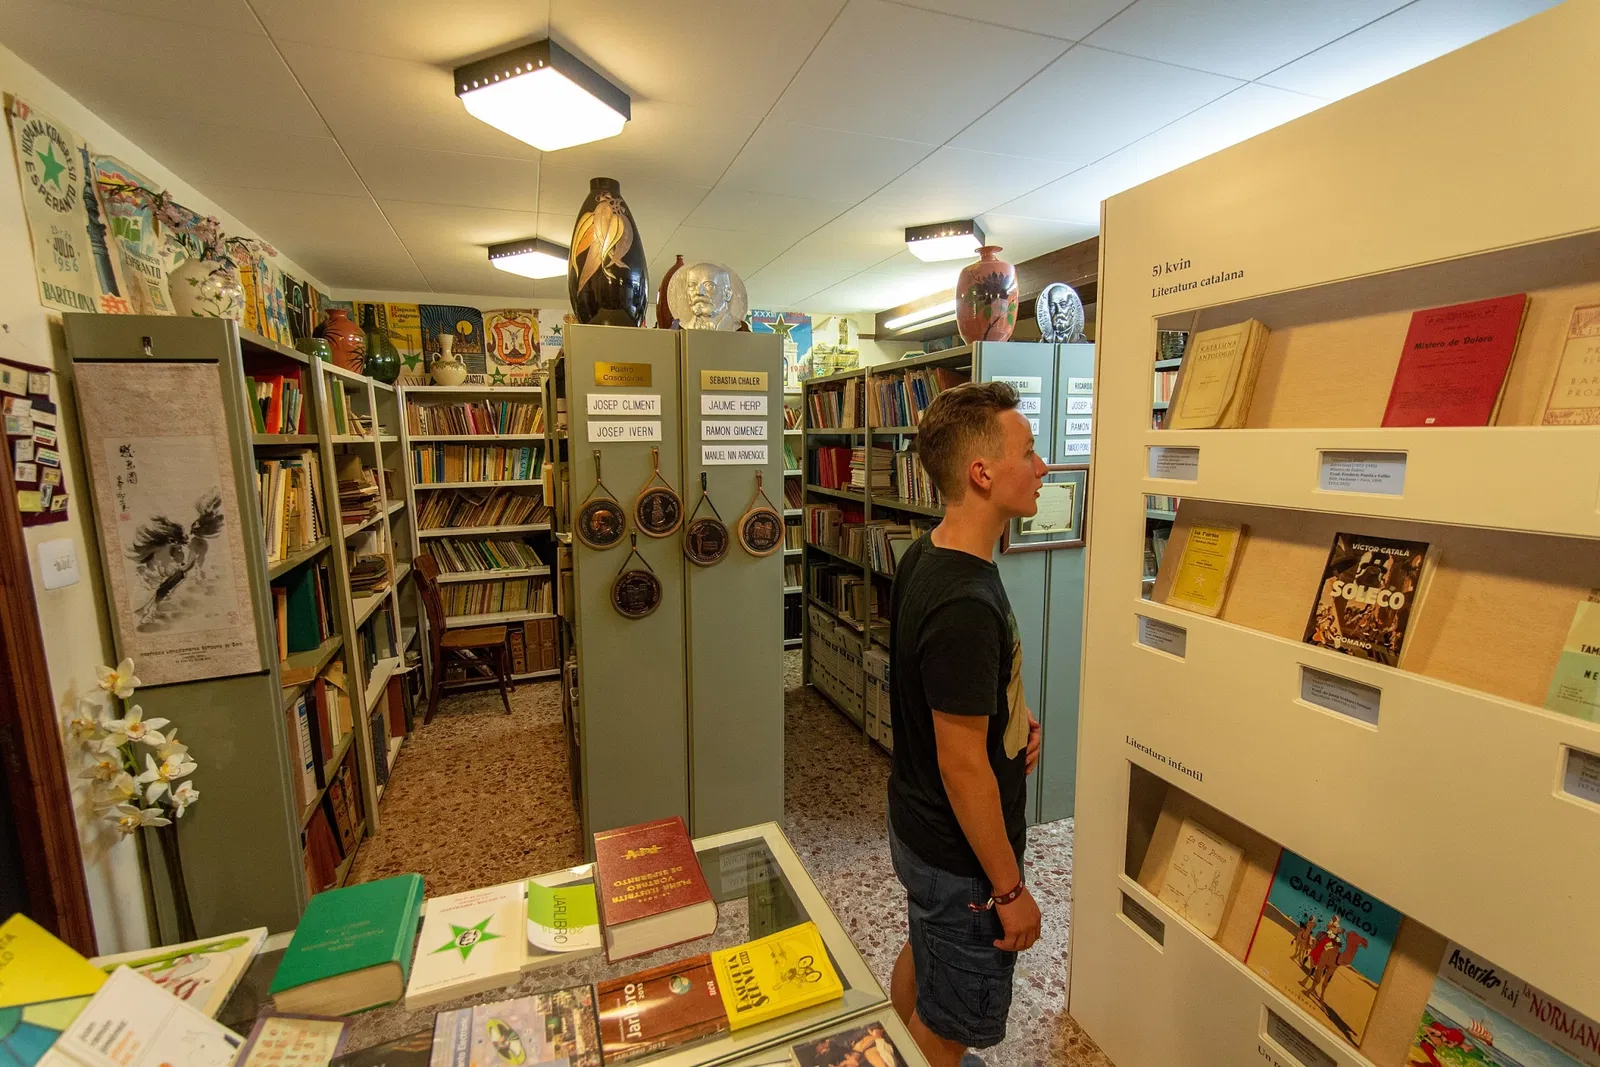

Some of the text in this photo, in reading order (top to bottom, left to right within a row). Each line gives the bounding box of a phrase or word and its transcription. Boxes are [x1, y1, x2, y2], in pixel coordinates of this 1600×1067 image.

[22, 119, 78, 182] HISPANA KONGRESO
[24, 160, 78, 214] ESPERANTO
[53, 253, 80, 272] 1956
[1152, 258, 1192, 278] 5) kvin
[1152, 268, 1245, 298] Literatura catalana
[42, 281, 97, 315] BARCELONA
[1413, 340, 1446, 350] Mistero
[1449, 339, 1459, 347] de
[738, 377, 760, 385] CHALER
[593, 399, 655, 411] JOSEP CLIMENT
[708, 400, 761, 411] JAUME HERP
[597, 426, 653, 438] JOSEP IVERN
[706, 426, 763, 436] RAMON GIMENEZ
[1070, 423, 1090, 431] RAMON
[704, 450, 765, 460] MANUEL NIN ARMENGOL
[1331, 580, 1404, 610] SOLECO
[1335, 634, 1372, 650] ROMANO
[1126, 735, 1204, 783] Literatura infantil
[613, 869, 668, 887] ESPERANTO
[627, 875, 674, 892] VORTARO
[611, 886, 662, 904] ILUSTRITA
[1306, 866, 1373, 914] LA KRABO
[1289, 876, 1378, 937] ORAJ PINĈILOJ
[552, 895, 568, 944] JARLIBRO
[636, 983, 645, 999] 2013
[741, 965, 770, 1009] SERVO
[1448, 949, 1501, 989] Asteriks
[1500, 980, 1519, 1008] kaj
[1522, 984, 1531, 999] la
[1529, 994, 1600, 1056] NORMAN
